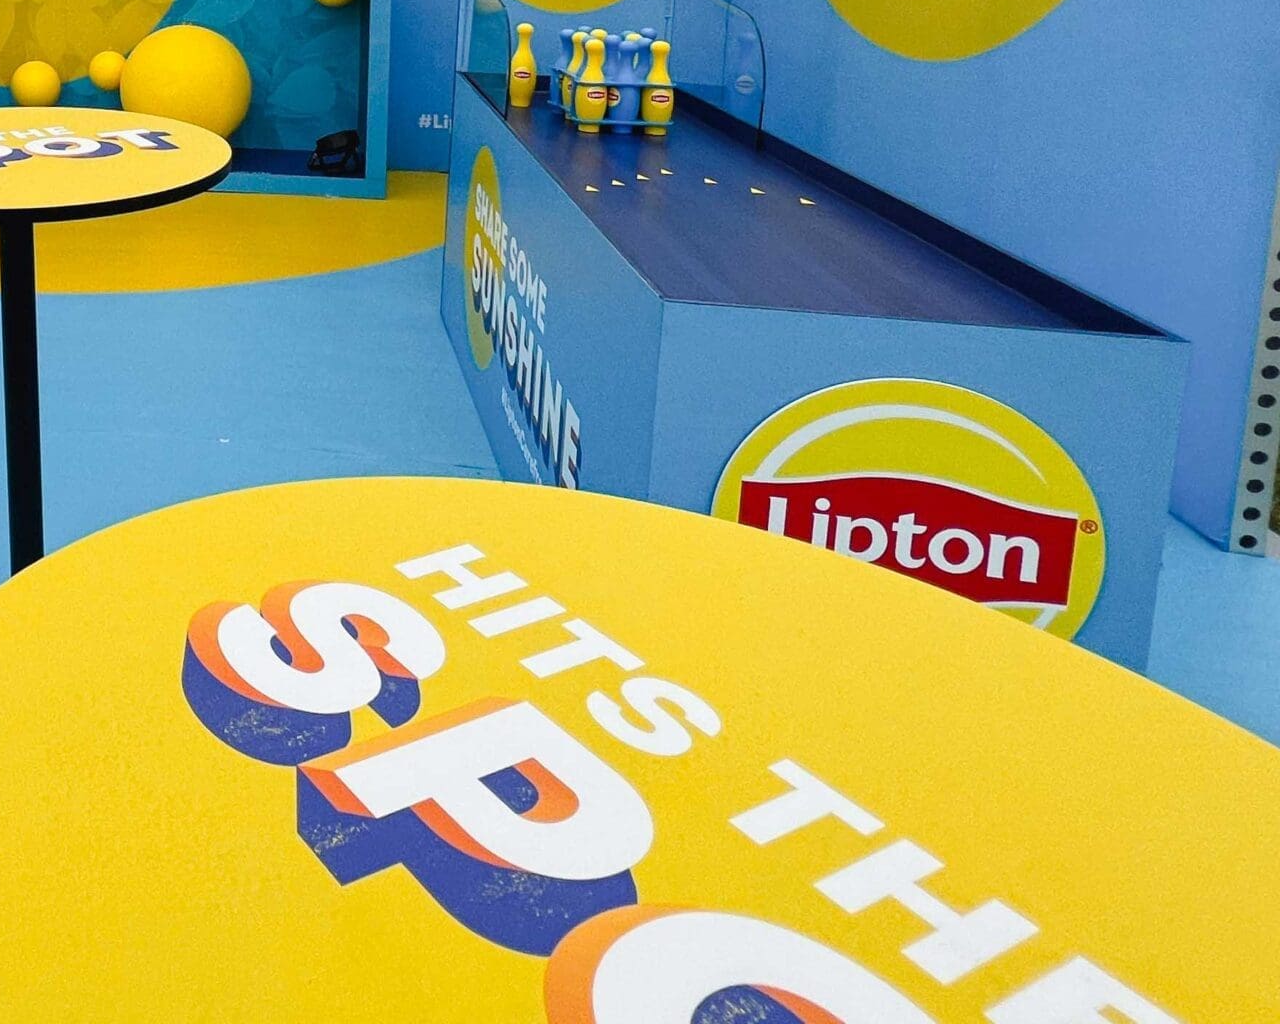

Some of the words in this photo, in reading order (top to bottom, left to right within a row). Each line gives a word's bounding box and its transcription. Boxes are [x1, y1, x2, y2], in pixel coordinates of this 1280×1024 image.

[418, 113, 451, 134] #Li
[474, 182, 508, 268] SHARE
[508, 236, 547, 335] SOME
[470, 232, 582, 490] SUNSHINE
[393, 543, 722, 758] HITS
